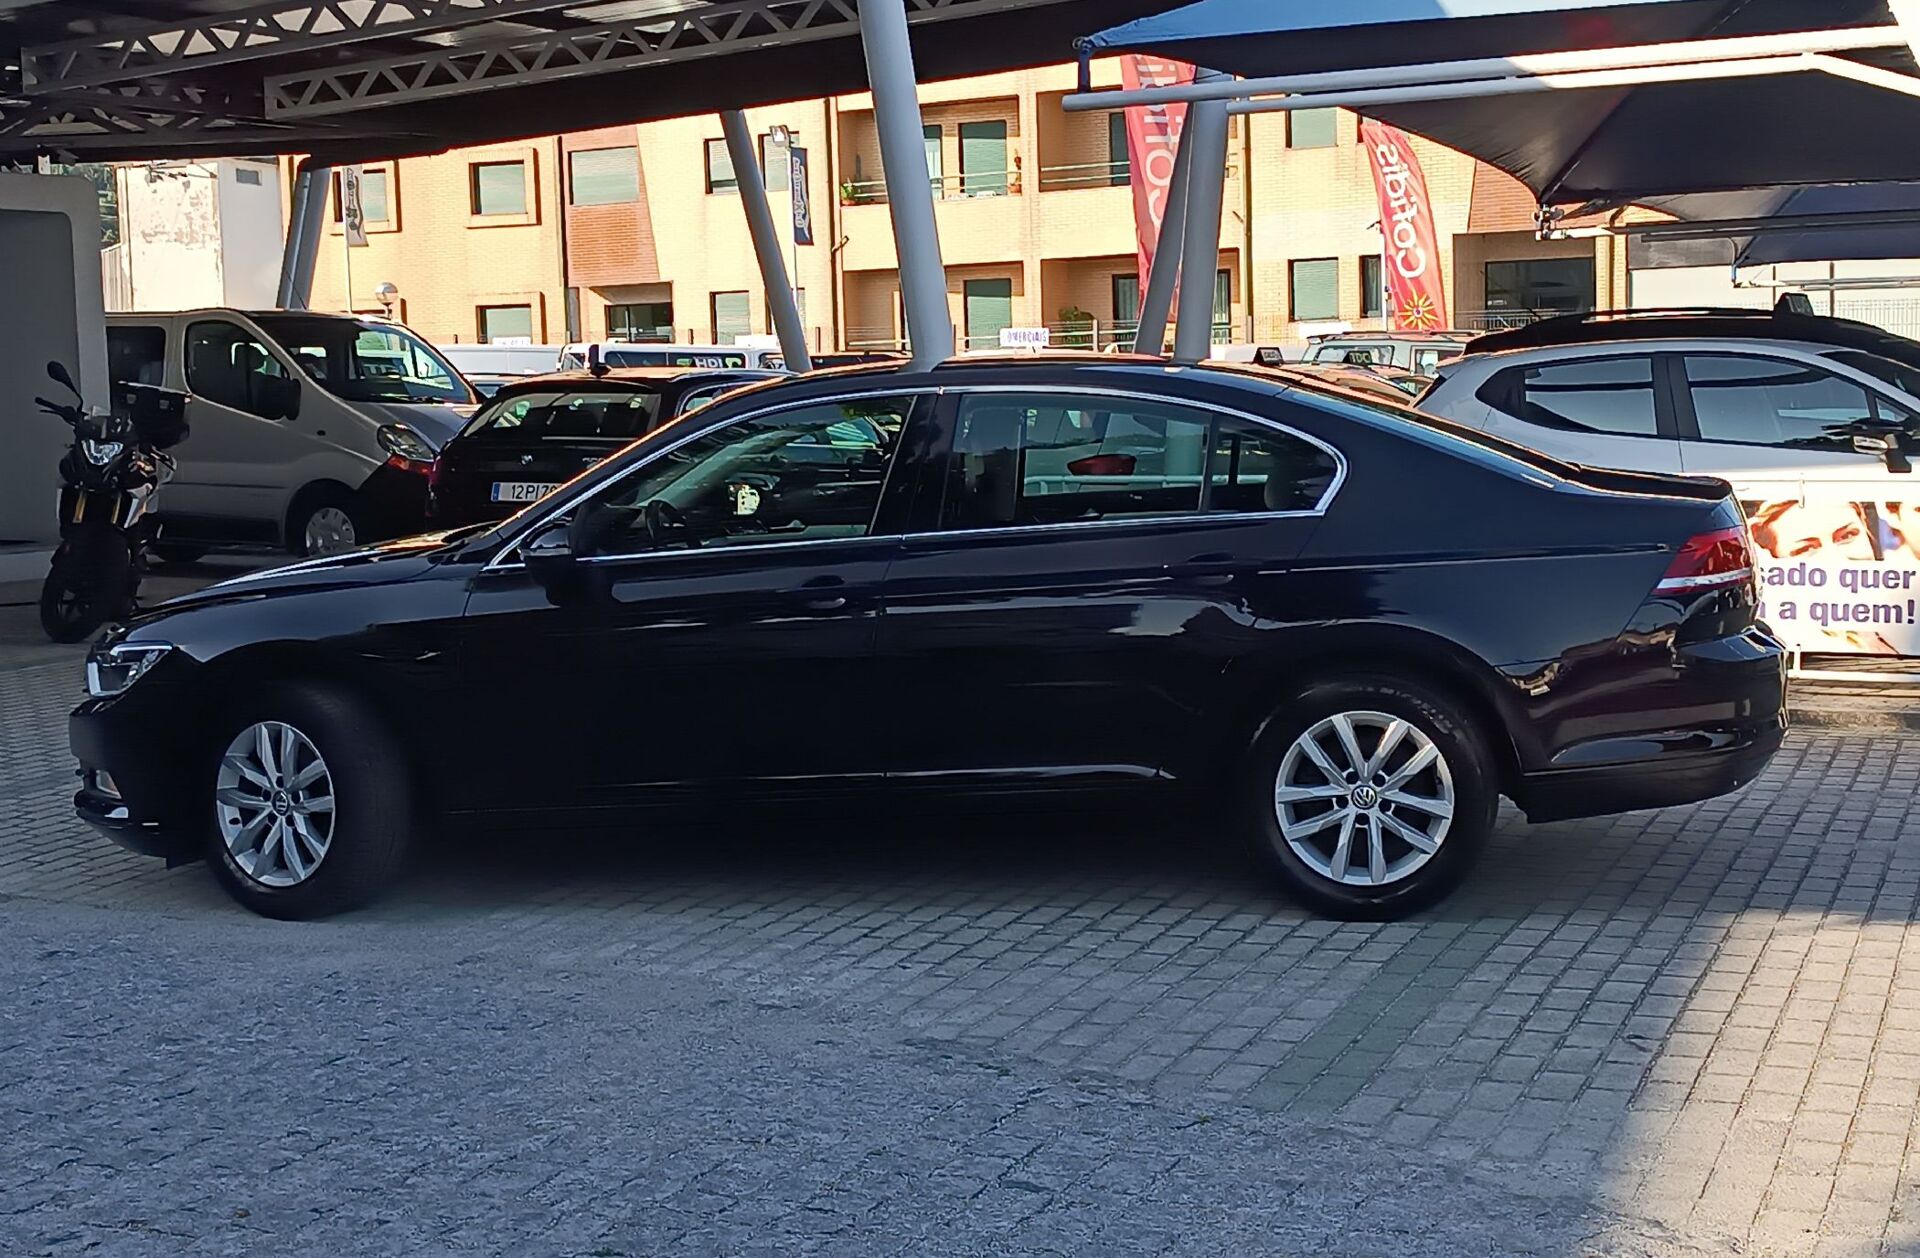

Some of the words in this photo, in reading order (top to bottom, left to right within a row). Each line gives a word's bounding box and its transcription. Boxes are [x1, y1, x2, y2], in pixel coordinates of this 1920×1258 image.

[1760, 562, 1827, 587] ado
[1839, 566, 1917, 593] quer
[1779, 601, 1797, 620] a
[1809, 600, 1915, 626] quem!
